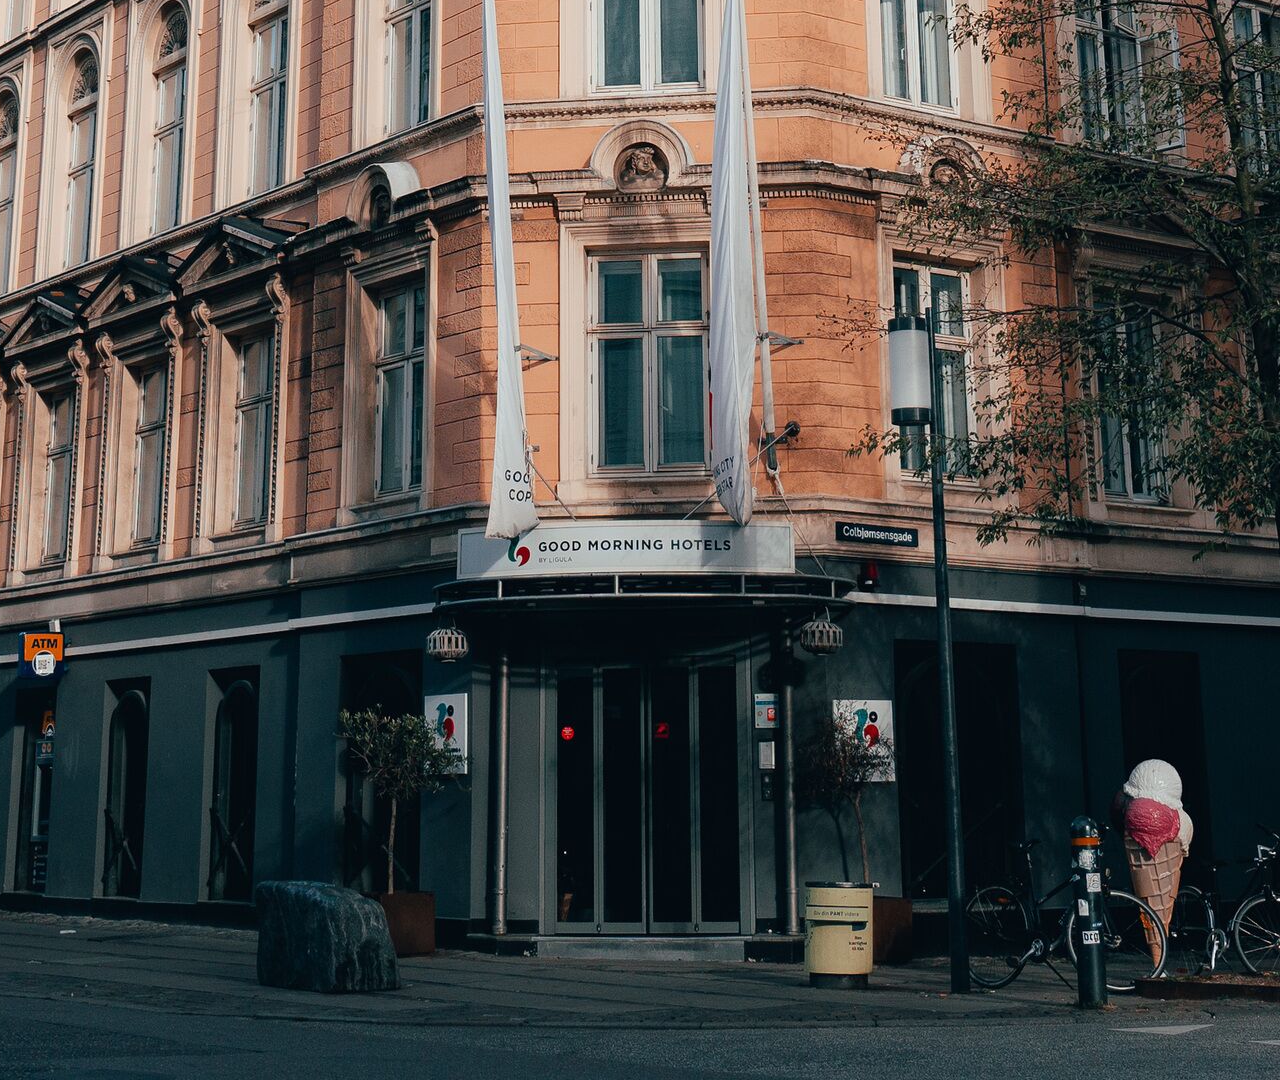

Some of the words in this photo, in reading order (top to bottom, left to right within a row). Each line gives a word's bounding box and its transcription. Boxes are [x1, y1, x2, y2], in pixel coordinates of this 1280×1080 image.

[538, 541, 582, 552] GOOD
[587, 539, 664, 551] MORNING
[671, 539, 731, 551] HOTELS
[31, 638, 58, 648] ATM
